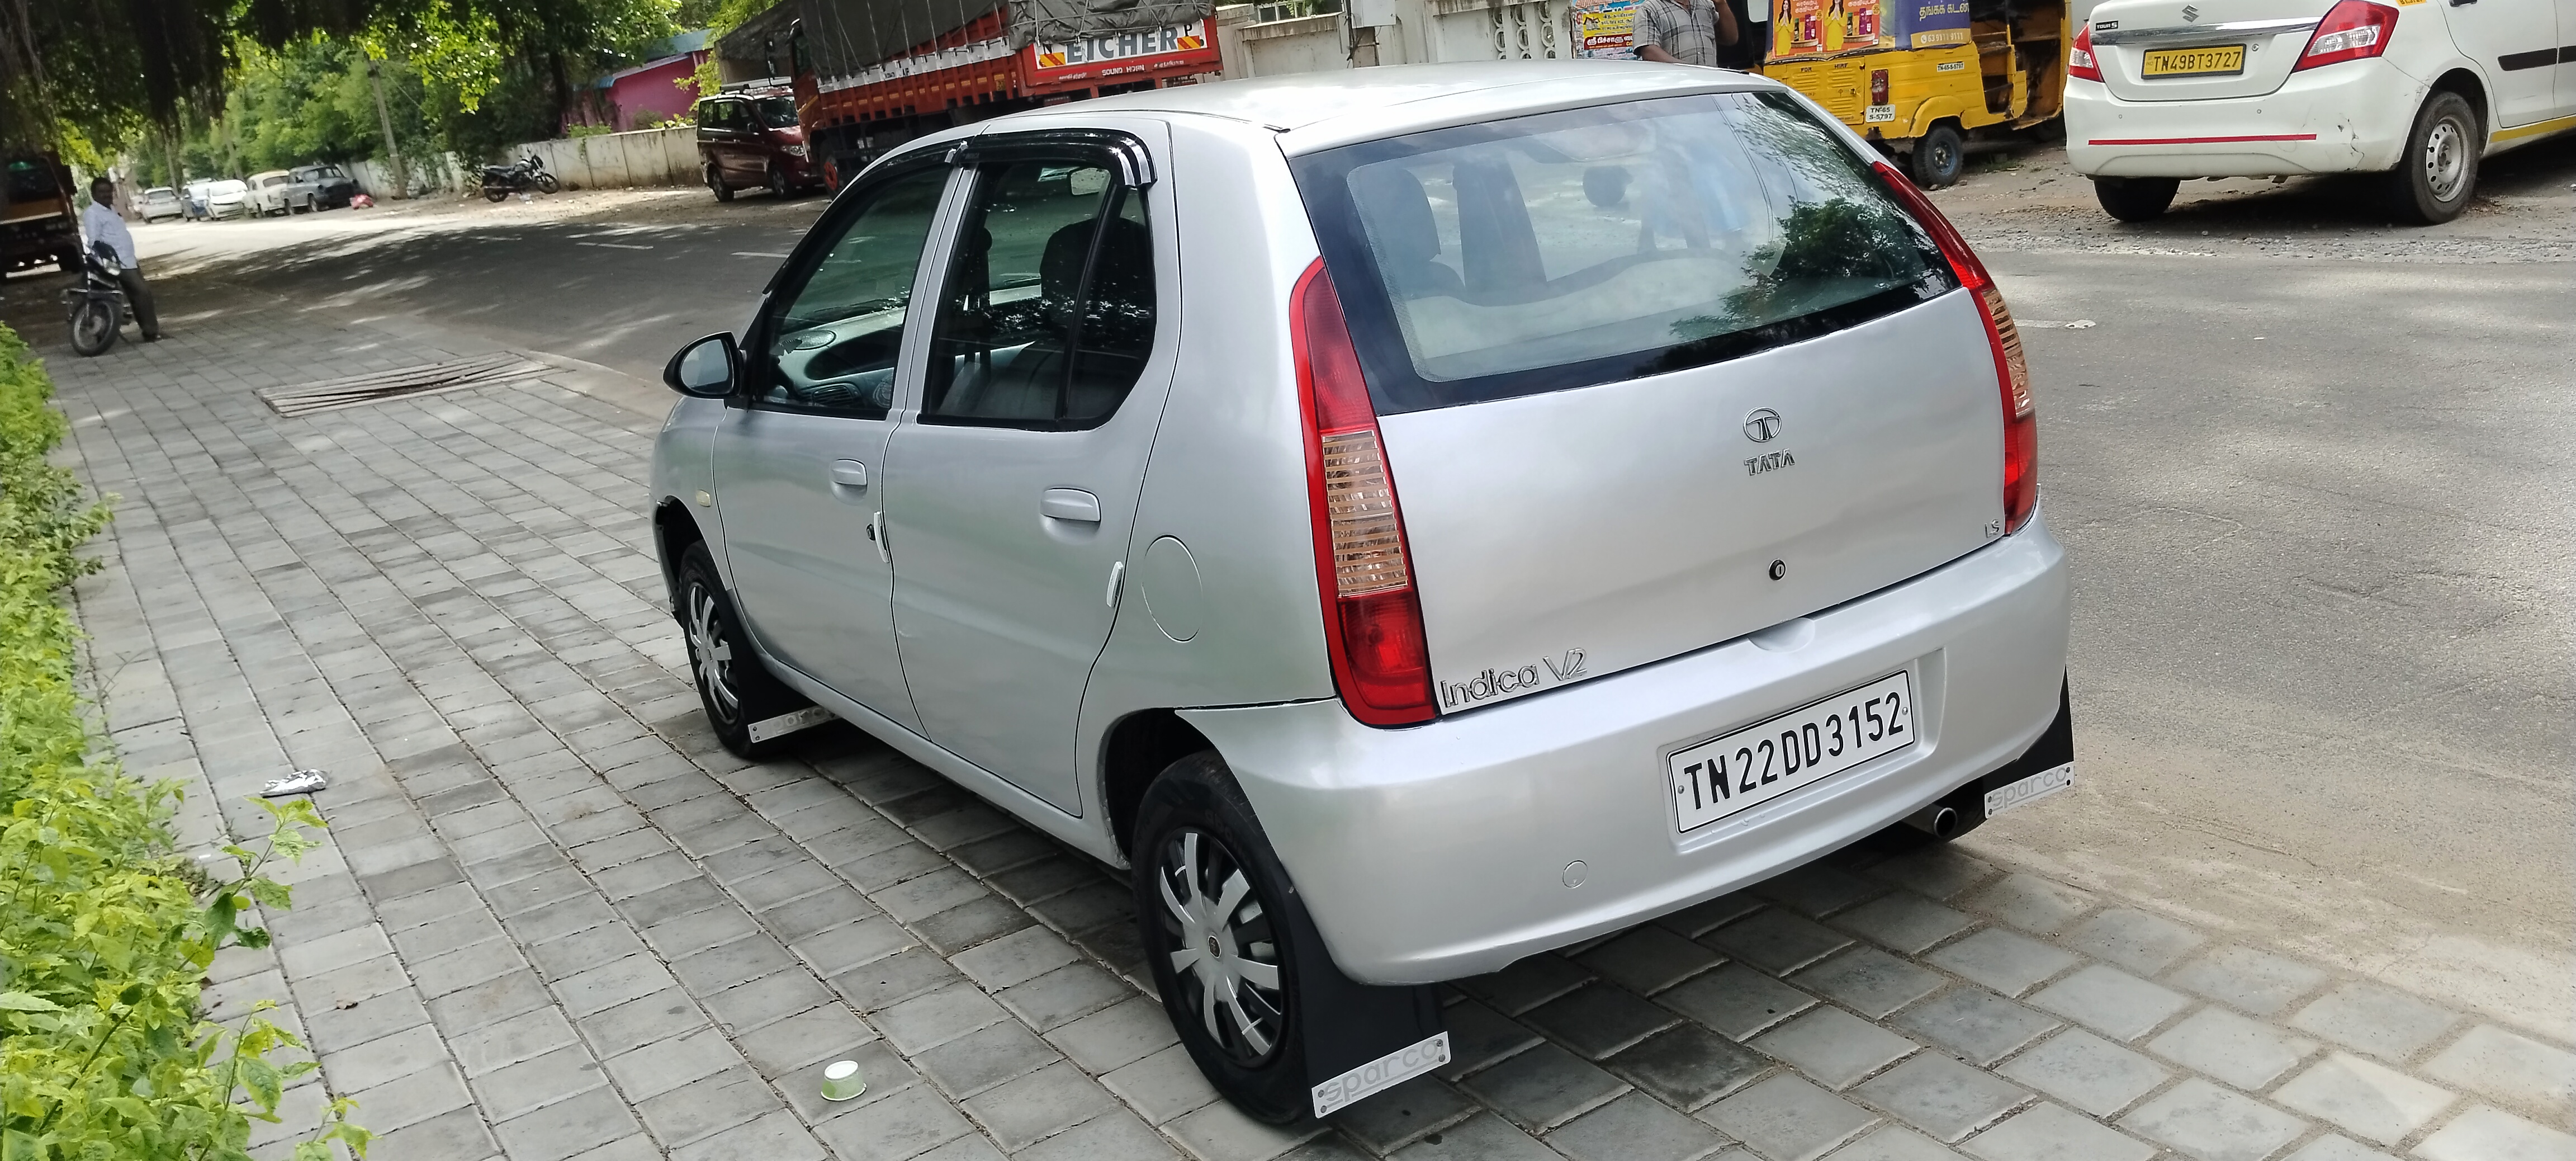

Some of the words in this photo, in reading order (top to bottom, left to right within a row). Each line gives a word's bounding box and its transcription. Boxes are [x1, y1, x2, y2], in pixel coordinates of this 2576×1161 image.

[1067, 26, 1178, 63] EICHER
[2153, 51, 2241, 72] TN49BT3727
[1101, 67, 1123, 76] SOUND
[1126, 64, 1144, 73] HORN
[1744, 448, 1796, 476] TATA
[1985, 518, 2000, 538] LS
[1441, 664, 1540, 708] Indica
[1542, 647, 1588, 681] V2
[1683, 691, 1904, 810] TN22DD3152
[1992, 767, 2067, 809] sparco
[1324, 1040, 1438, 1103] sparco
